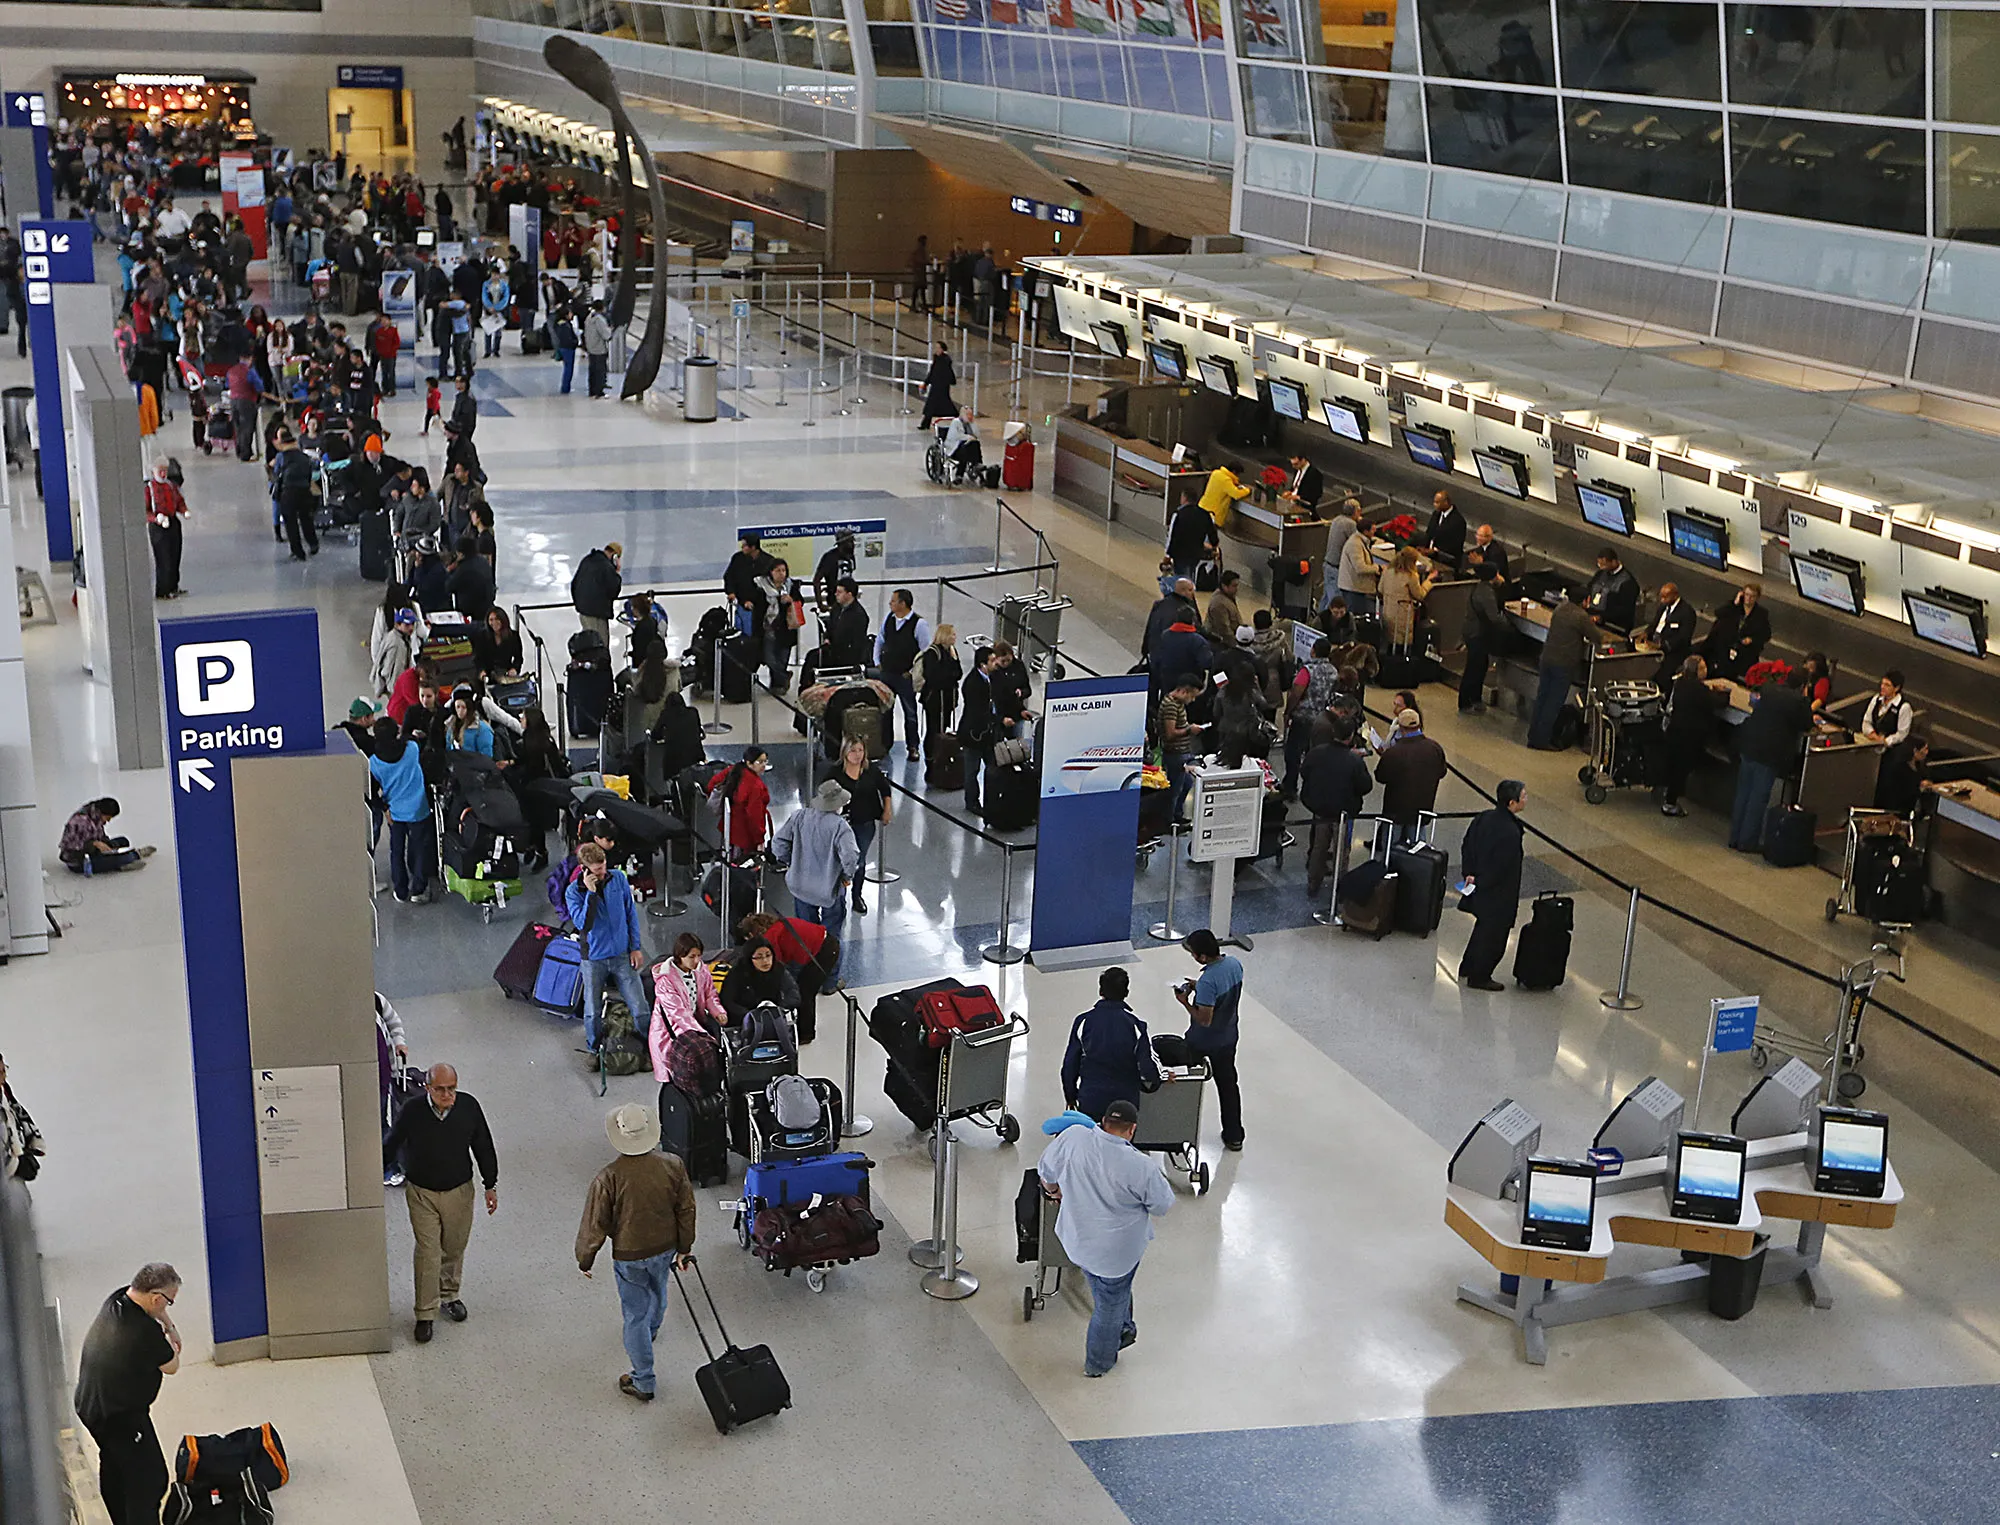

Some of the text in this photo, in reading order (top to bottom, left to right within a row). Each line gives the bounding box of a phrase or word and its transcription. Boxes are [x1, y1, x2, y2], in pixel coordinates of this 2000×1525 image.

[737, 305, 744, 315] 2
[1373, 386, 1386, 399] 124
[1405, 394, 1418, 407] 125
[1536, 437, 1551, 449] 126
[1576, 447, 1589, 460] 127
[1740, 499, 1757, 513] 128
[1790, 513, 1807, 527] 129
[196, 654, 235, 702] P
[1052, 700, 1112, 713] MAIN CABIN
[180, 723, 284, 751] Parking
[1081, 745, 1142, 757] American
